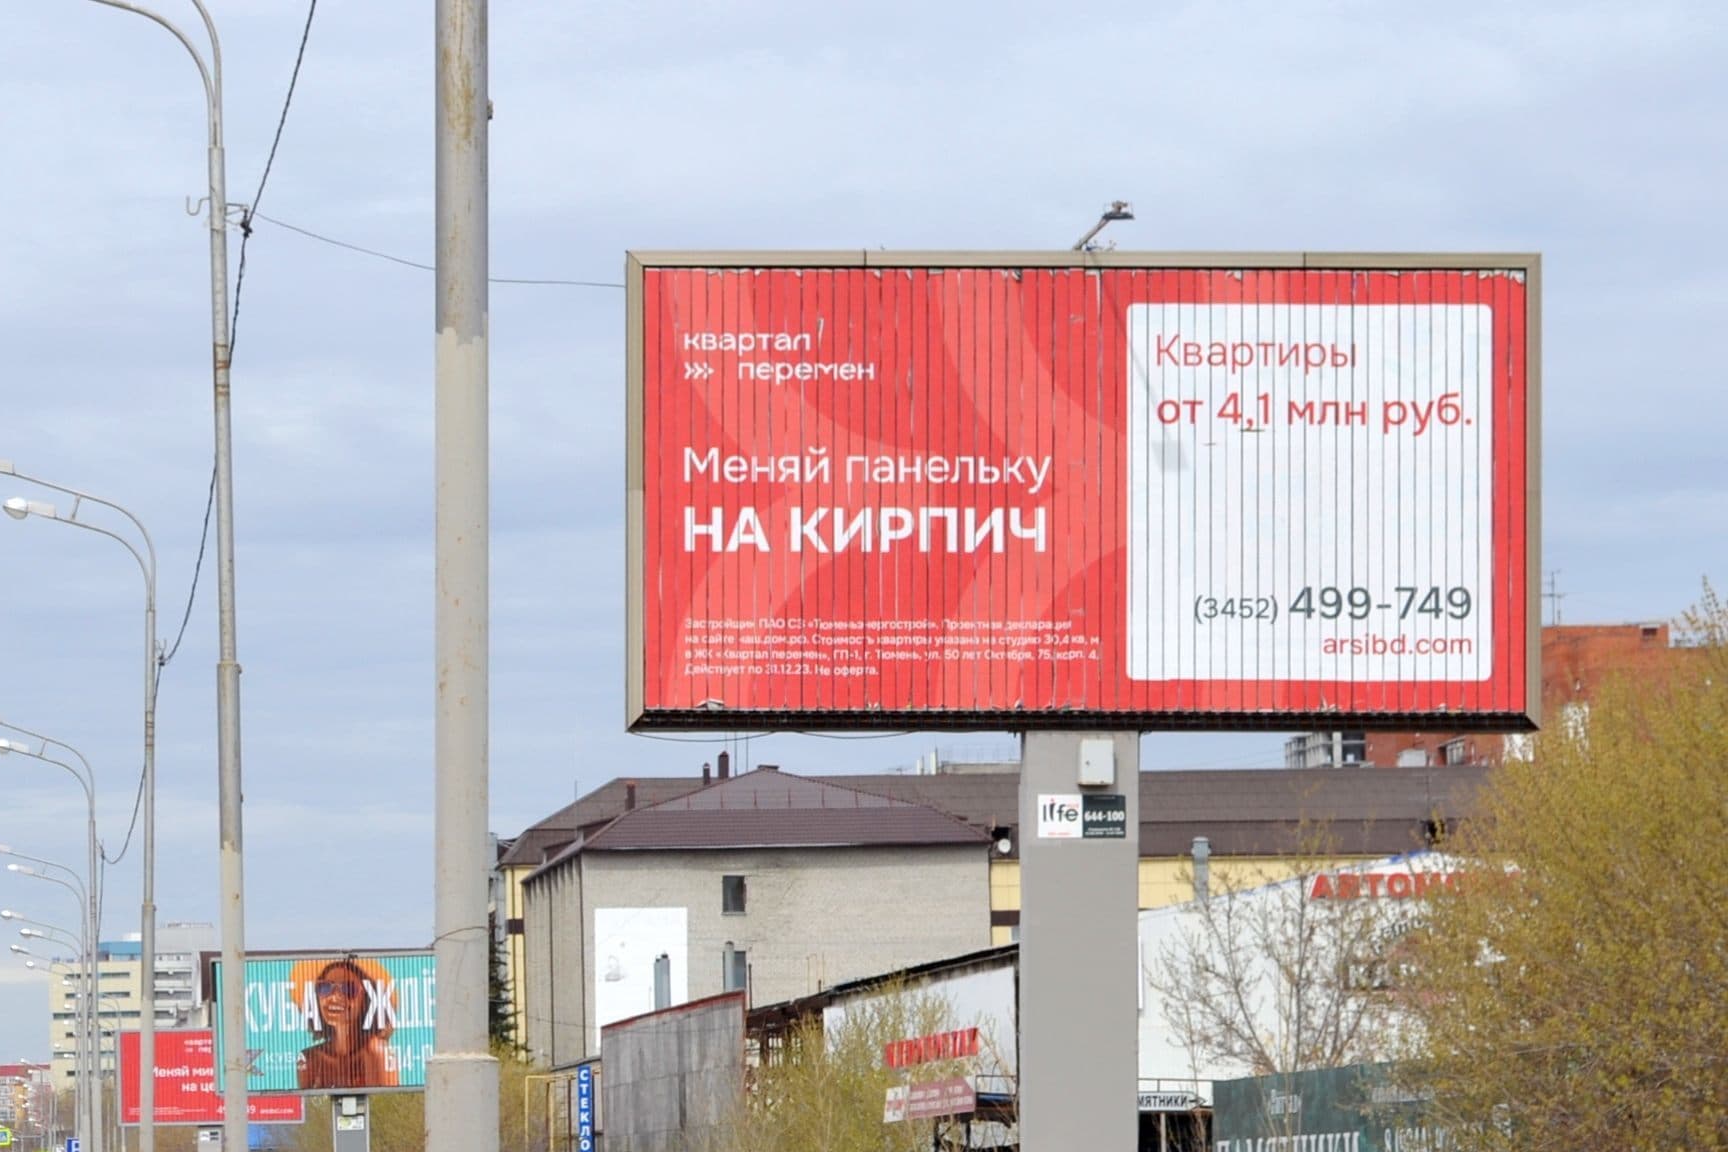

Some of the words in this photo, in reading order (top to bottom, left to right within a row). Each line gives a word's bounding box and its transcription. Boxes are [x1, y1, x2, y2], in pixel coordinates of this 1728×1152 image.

[683, 332, 811, 357] квартал
[1155, 334, 1357, 375] Квартиры
[738, 361, 875, 385] перемен
[1157, 399, 1203, 425] от
[1216, 392, 1270, 430] 4,1
[1287, 399, 1368, 426] млн
[1382, 391, 1473, 437] руб.
[683, 445, 830, 484] Меняй
[845, 453, 1052, 495] панельку
[683, 506, 771, 553] НА
[790, 506, 1047, 553] КИРПИЧ
[758, 617, 786, 629] ПАО
[1194, 594, 1279, 625] (3452)
[1288, 586, 1473, 621] 499-749
[1322, 632, 1473, 656] arsibd.com
